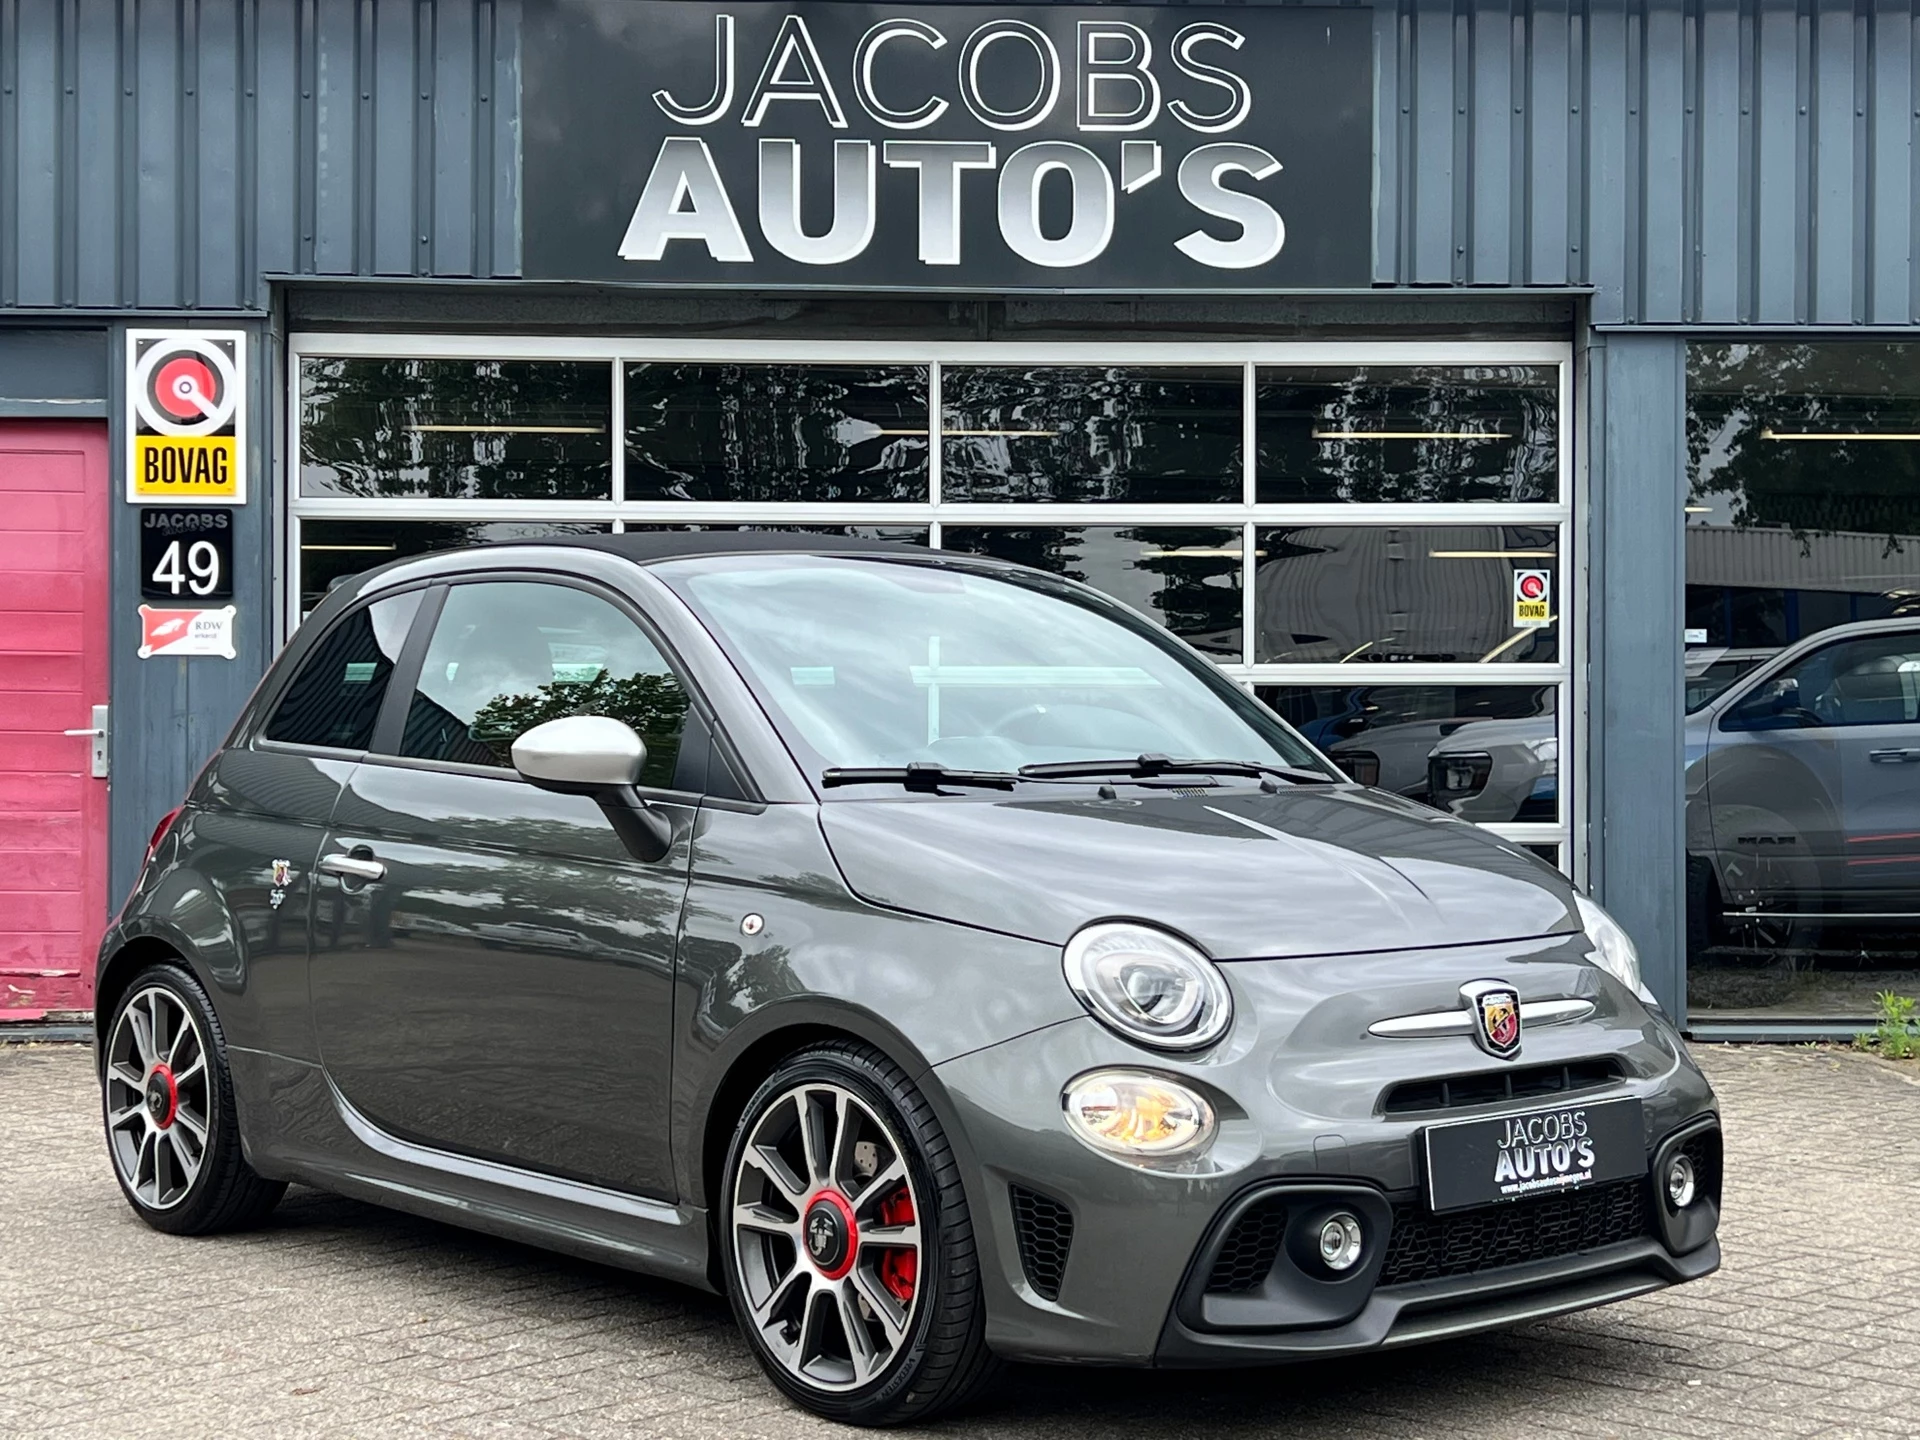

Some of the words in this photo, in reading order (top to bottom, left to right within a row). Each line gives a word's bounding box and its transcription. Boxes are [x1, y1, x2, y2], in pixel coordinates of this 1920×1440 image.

[652, 14, 1252, 134] JACOBS
[617, 136, 1286, 269] AUTO'S
[144, 446, 228, 484] BOVAG
[143, 513, 228, 529] JACOBS
[152, 540, 219, 595] 49
[195, 621, 224, 630] RDW
[1518, 604, 1545, 617] BOVAG
[1497, 1111, 1587, 1148] JACOBS
[1494, 1136, 1595, 1182] AUTO'S
